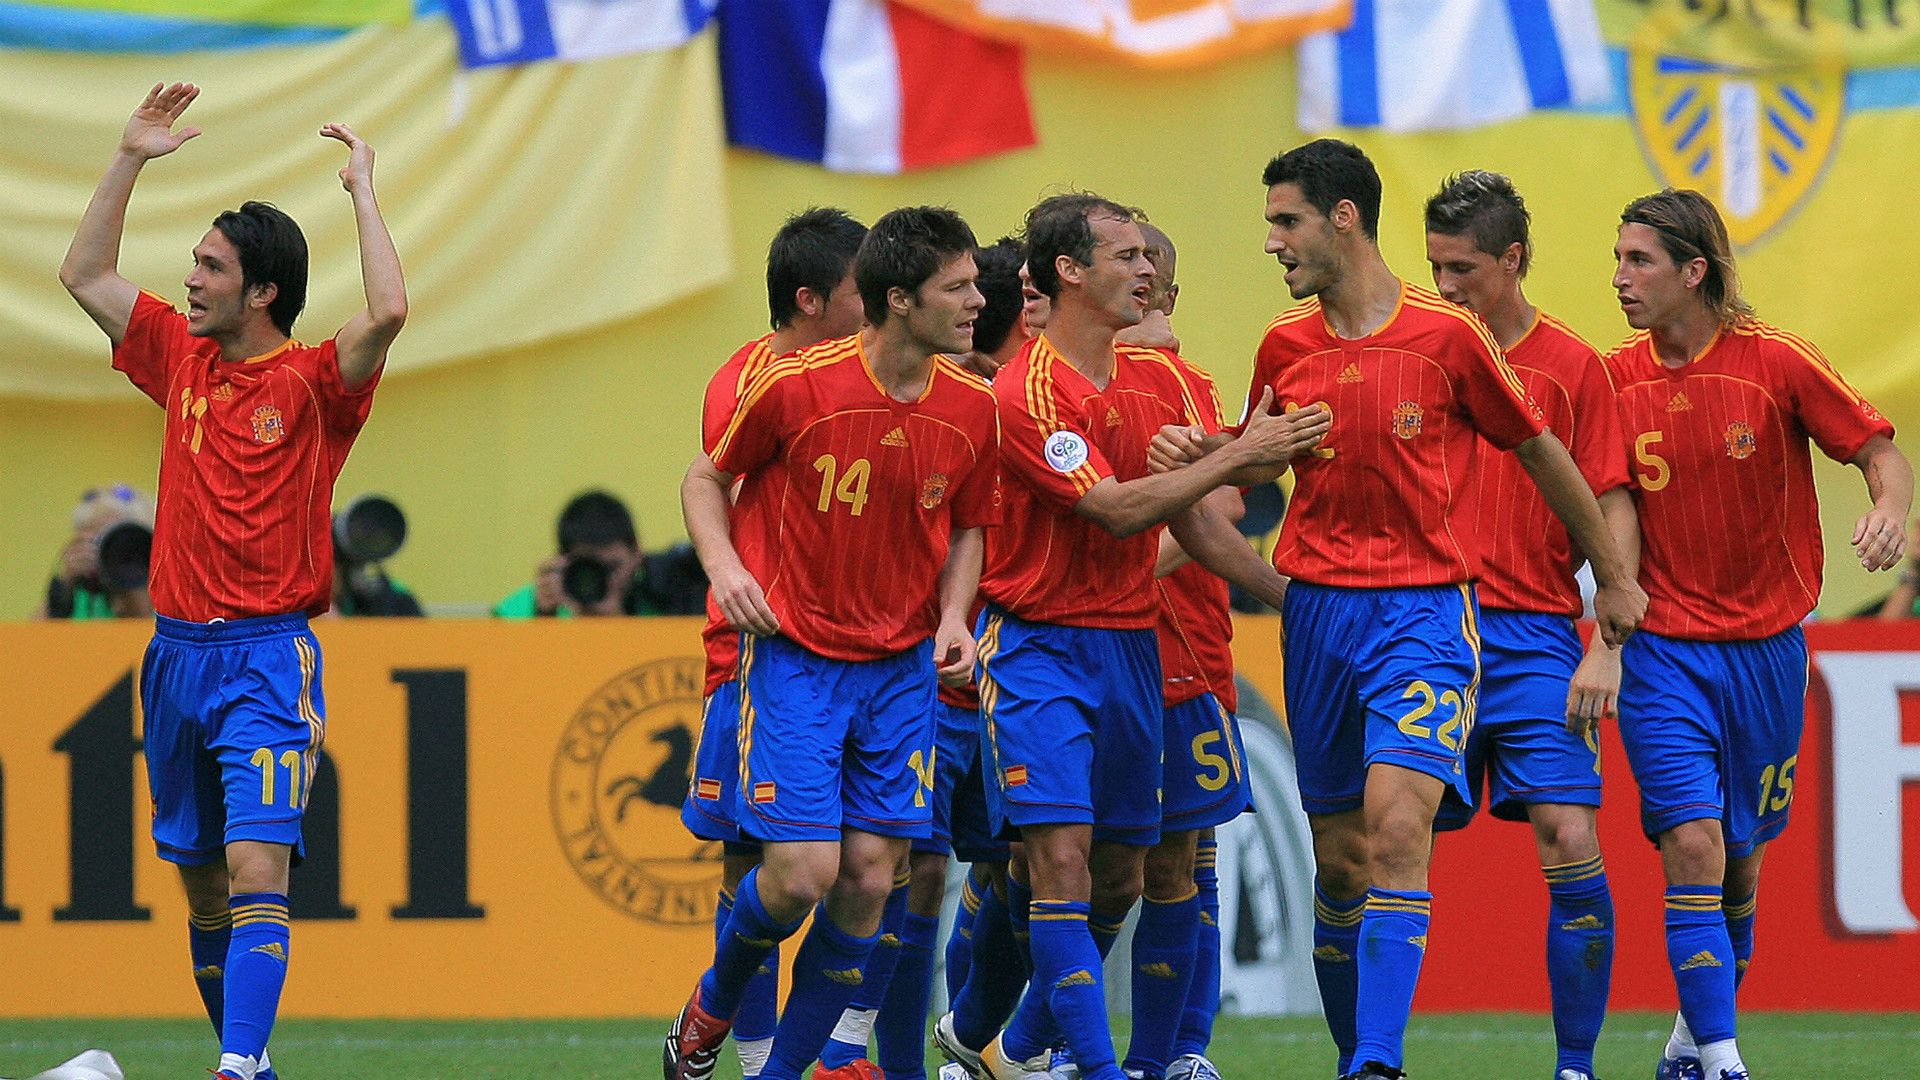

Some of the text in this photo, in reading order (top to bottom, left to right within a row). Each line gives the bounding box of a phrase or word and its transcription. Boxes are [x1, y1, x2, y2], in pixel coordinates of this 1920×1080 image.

[813, 453, 872, 516] 14
[1398, 679, 1462, 752] 22
[250, 747, 302, 809] 11
[1191, 729, 1231, 792] 5
[1757, 753, 1799, 818] 15
